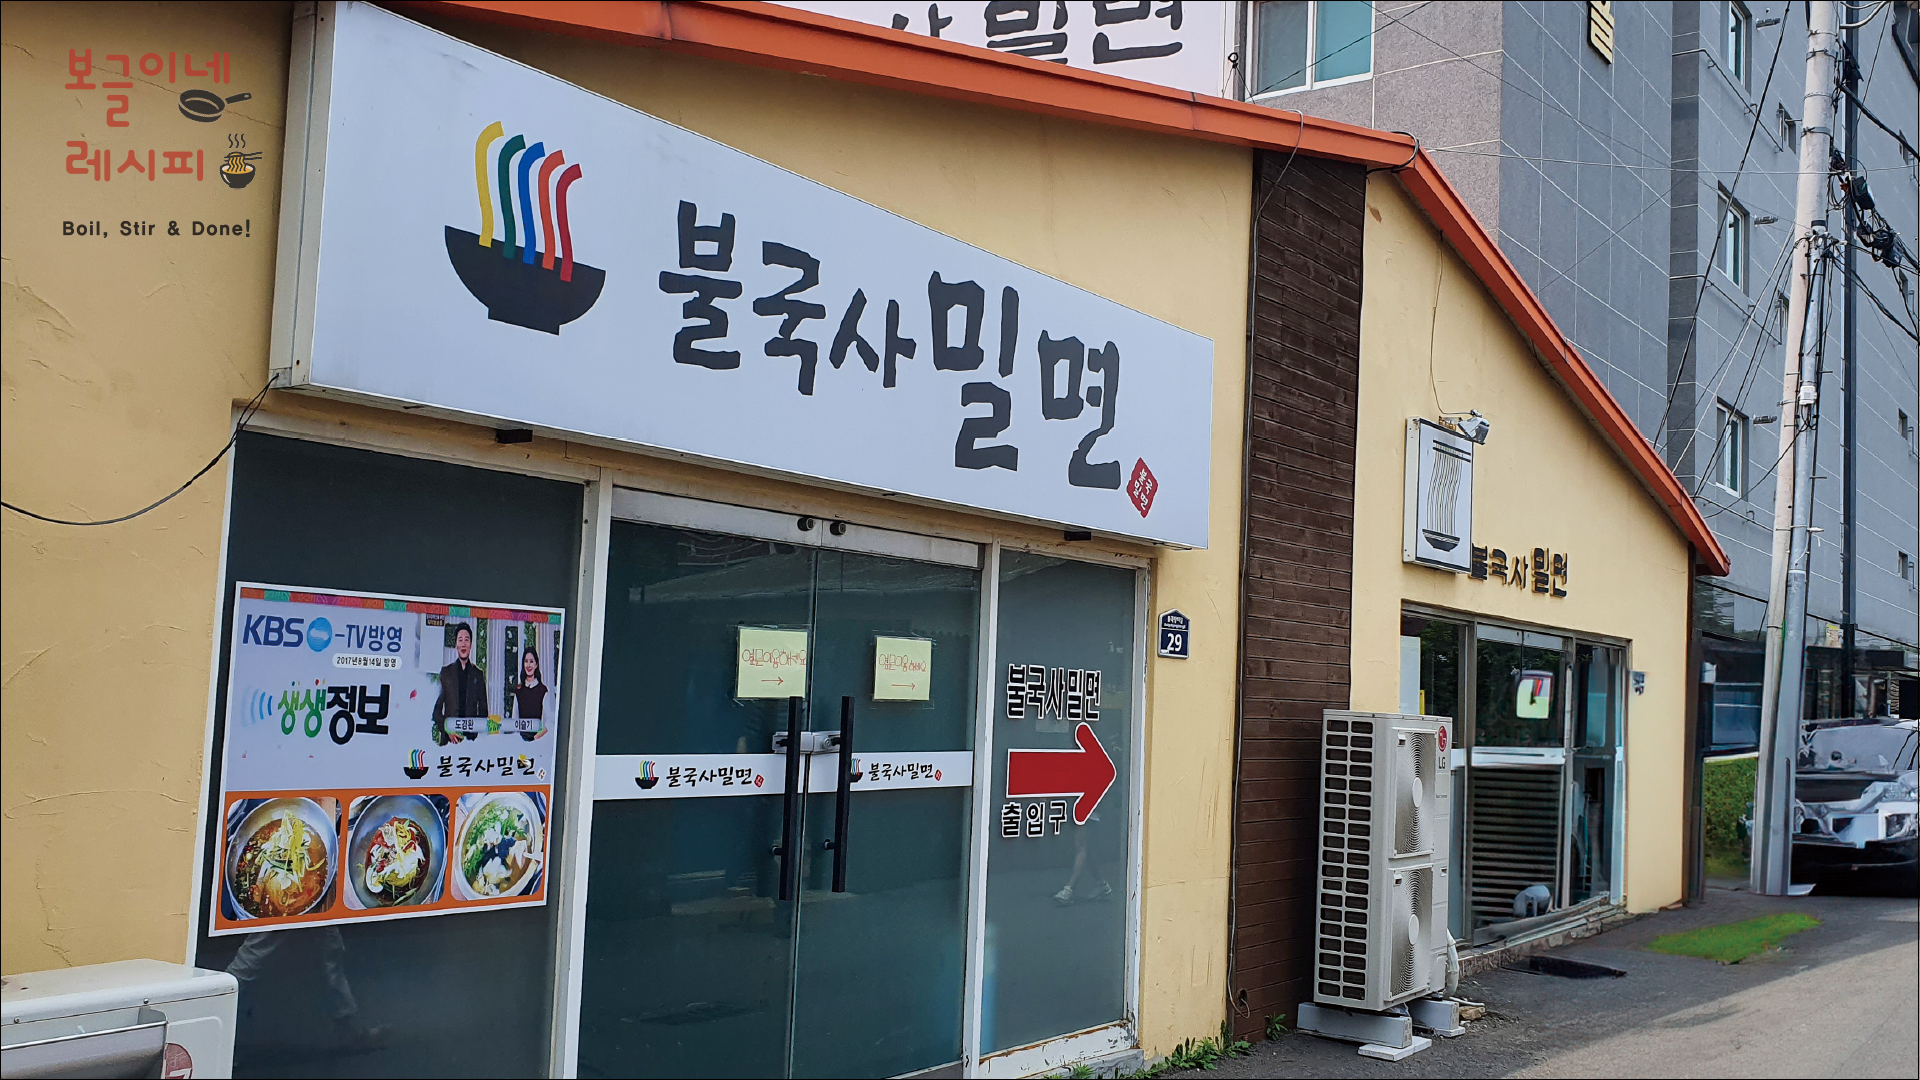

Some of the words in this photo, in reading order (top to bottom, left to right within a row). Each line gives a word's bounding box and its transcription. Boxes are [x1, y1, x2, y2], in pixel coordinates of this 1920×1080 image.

[659, 200, 1121, 491] 불국사밀면
[242, 614, 304, 648] KBS
[1167, 633, 1182, 652] 29
[383, 658, 397, 668] 방영
[1006, 663, 1102, 721] 불국사밀면
[278, 684, 391, 745] 생생정보
[868, 762, 934, 781] 불국사밀면
[1438, 756, 1446, 769] LG
[666, 766, 753, 788] 불국사밀면
[1001, 801, 1068, 838] 출입구
